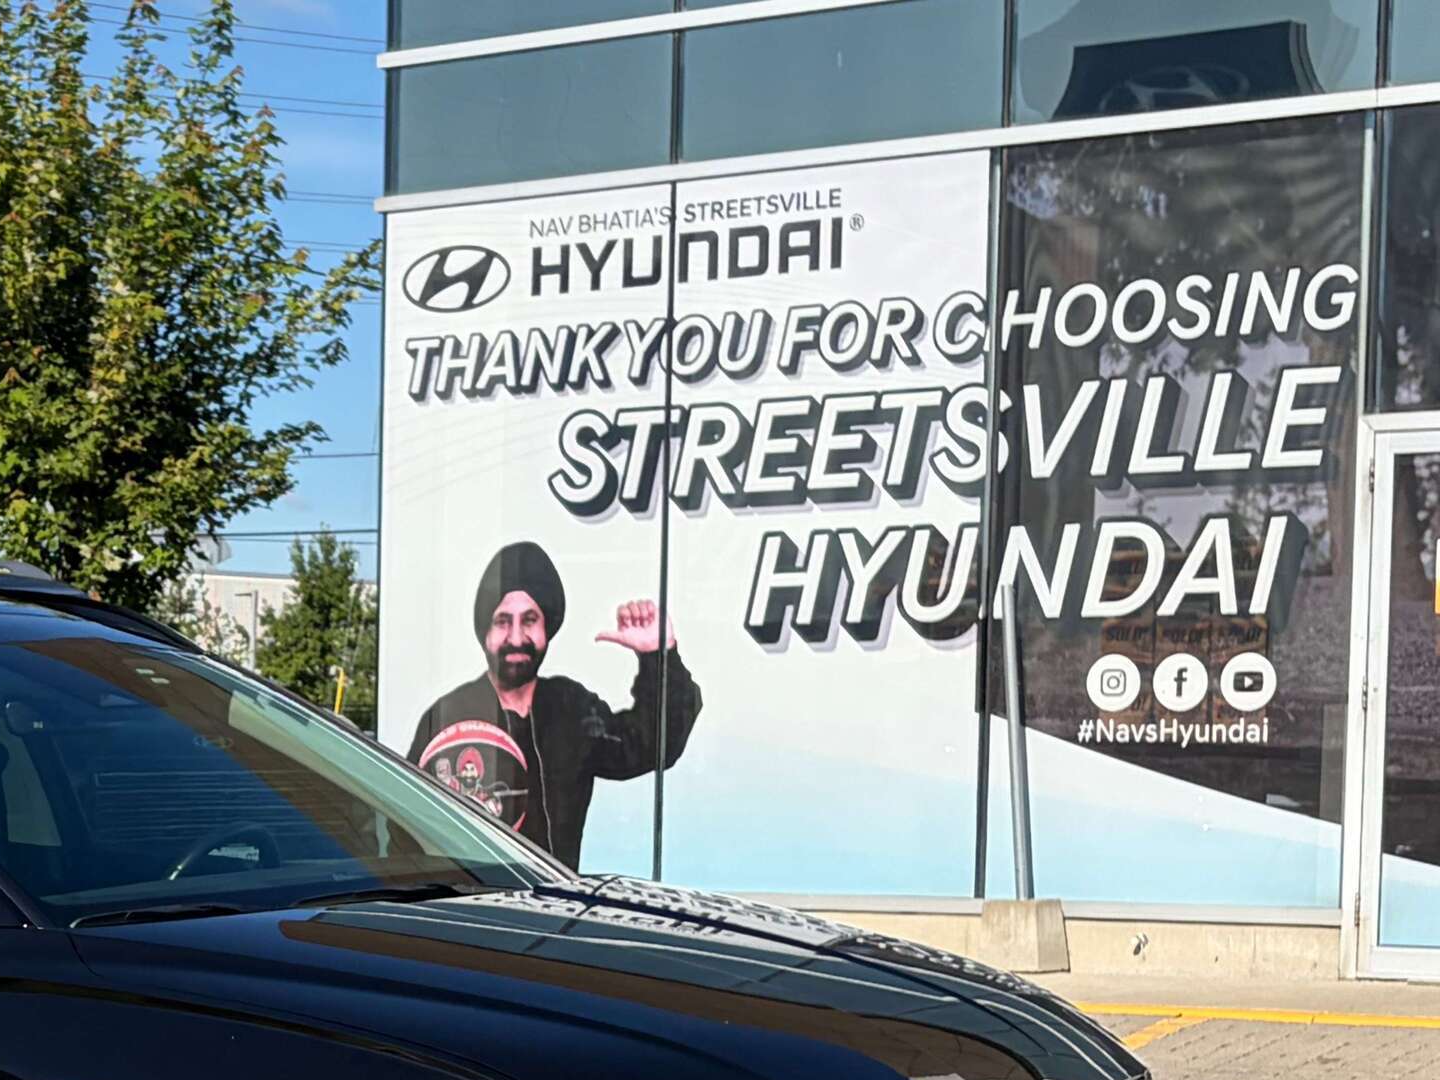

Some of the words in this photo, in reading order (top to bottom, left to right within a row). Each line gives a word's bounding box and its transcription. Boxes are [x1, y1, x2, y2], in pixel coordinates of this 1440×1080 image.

[528, 215, 574, 239] NAV
[578, 206, 676, 234] BHATIA'S
[683, 188, 843, 223] STREETSVILLE
[406, 322, 620, 401] THANK
[623, 309, 773, 382] YOU
[778, 297, 925, 375] FOR
[934, 264, 1359, 365] CHOOSING
[548, 365, 1344, 517] STREETSVILLE
[744, 514, 1304, 642] HYUNDAI
[1077, 717, 1270, 748] #NavsHyundai
